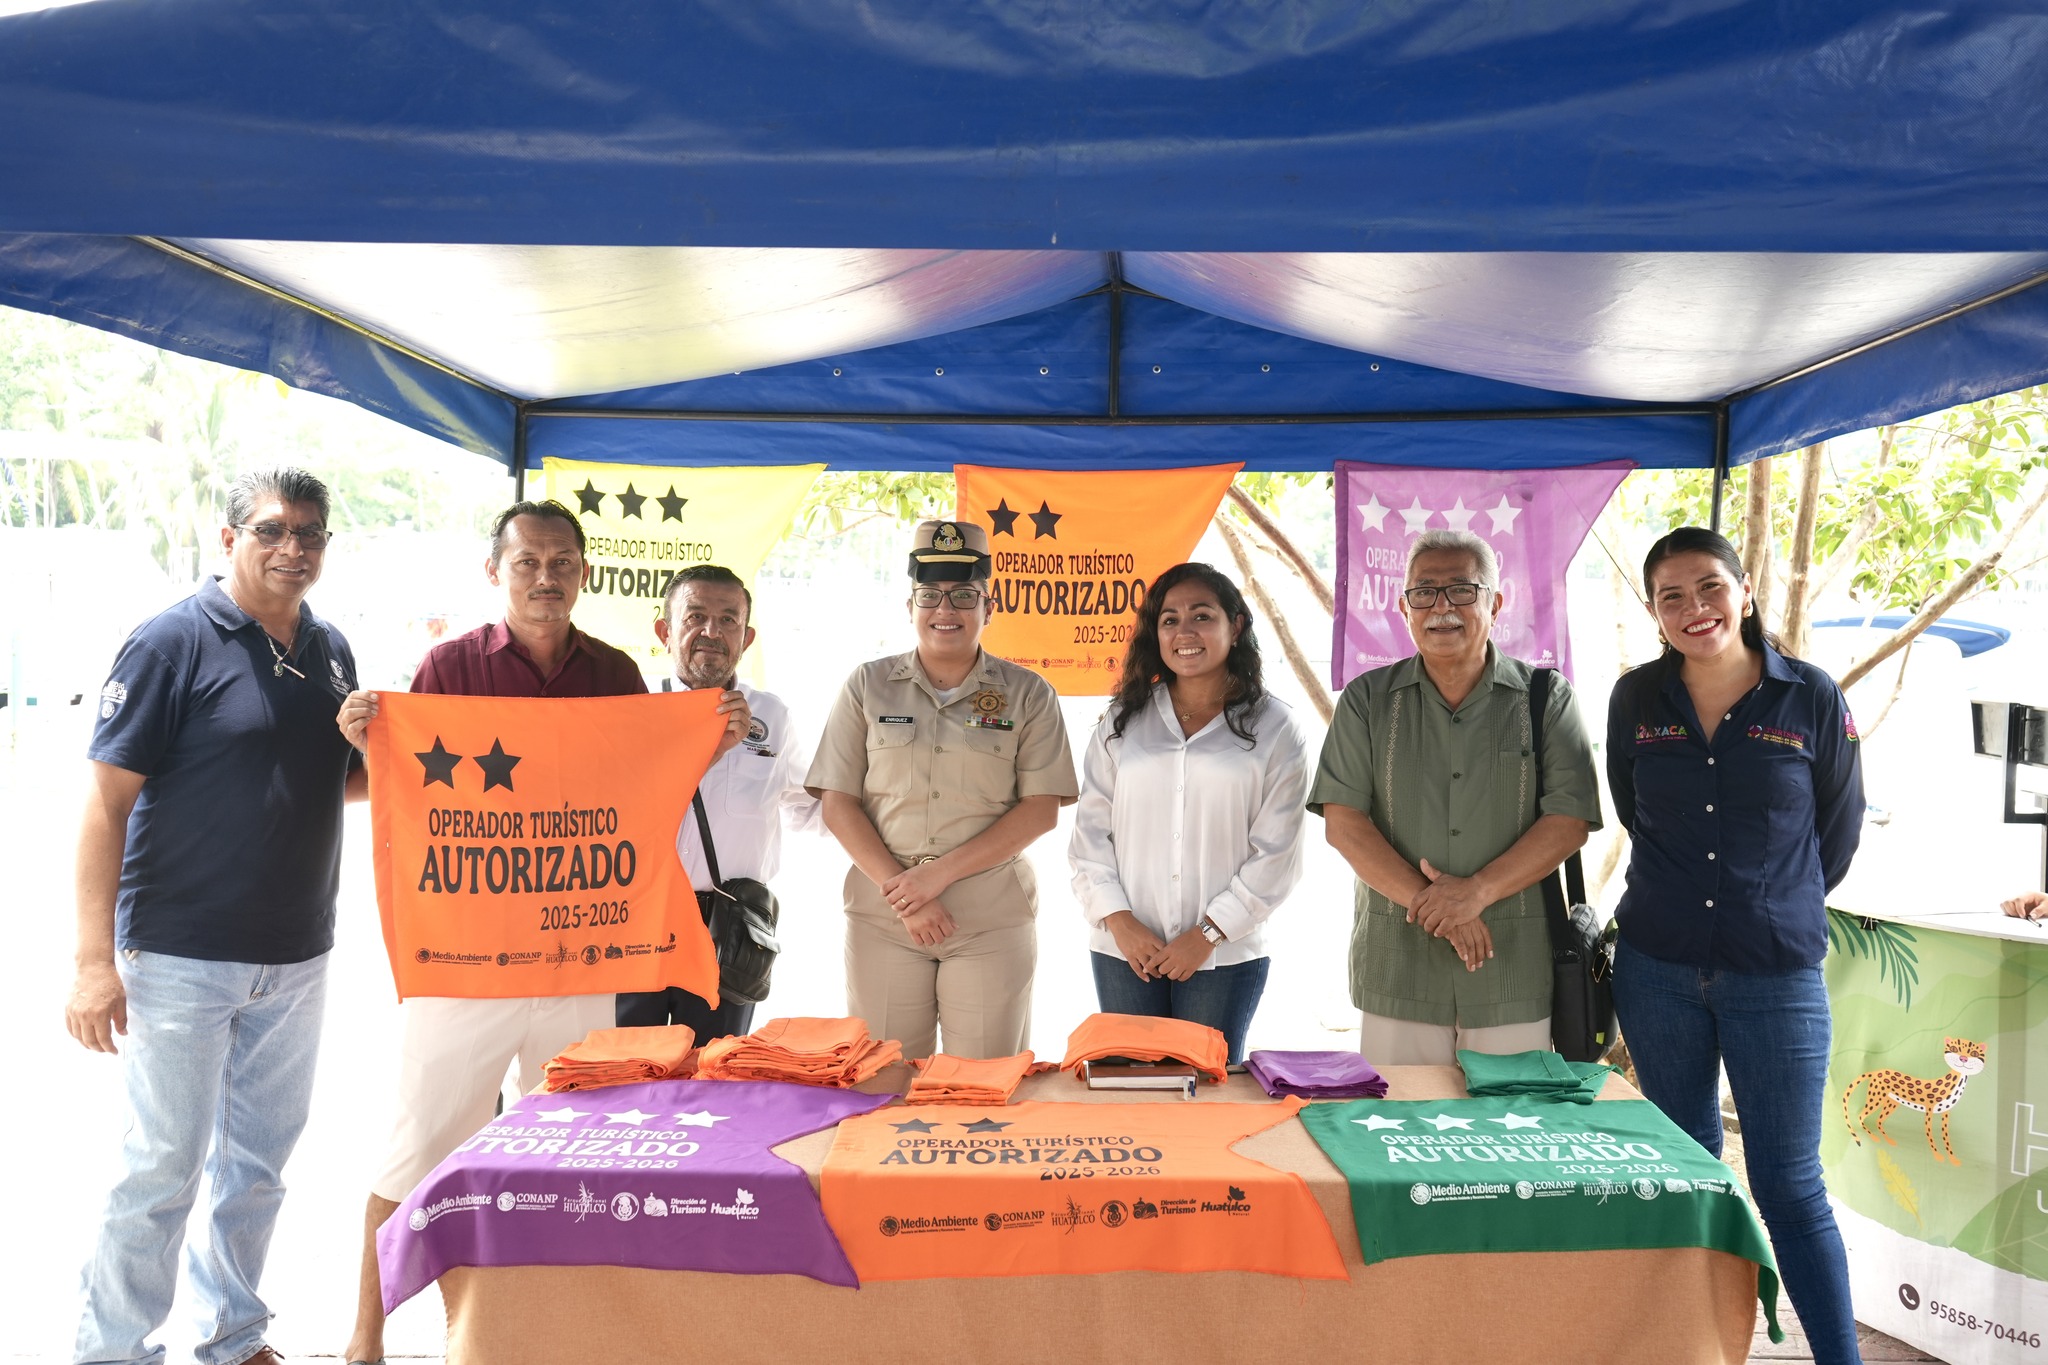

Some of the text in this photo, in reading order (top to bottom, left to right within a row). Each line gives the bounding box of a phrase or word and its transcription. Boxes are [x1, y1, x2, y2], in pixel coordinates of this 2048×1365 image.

[650, 537, 713, 561] TURÍSTICO
[996, 549, 1134, 575] OPERADOR TURÍSTICO
[1366, 547, 1406, 571] OPERA
[583, 565, 675, 598] UTORIZ
[991, 578, 1147, 615] AUTORIZADO
[428, 801, 618, 839] OPERADOR TURÍSTICO
[418, 840, 636, 895] AUTORIZADO
[540, 900, 629, 931] 2025-2026
[432, 951, 492, 962] Medio Ambiente
[510, 952, 542, 960] CONANP
[480, 1126, 688, 1140] ERADOR TURÍSTICO
[1381, 1131, 1617, 1146] OPERADOR TURÍSTICO
[456, 1136, 700, 1157] UTORIZADO
[897, 1134, 1134, 1149] OPERADOR TURÍSTICO
[879, 1147, 1163, 1165] AUTORIZADO
[1388, 1143, 1662, 1163] AUTORIZADO
[557, 1158, 679, 1169] 2025-2026
[1556, 1163, 1679, 1175] 2025-2026
[1040, 1166, 1161, 1181] 2025-2026
[1432, 1183, 1510, 1197] Medio Ambiente
[1534, 1180, 1577, 1190] CONANP
[1584, 1184, 1629, 1196] HUATULCO
[1693, 1182, 1726, 1194] Turismo
[517, 1193, 558, 1203] CONANP
[670, 1198, 698, 1206] Dirección
[1160, 1199, 1188, 1207] Dirección
[427, 1197, 455, 1217] Medio
[455, 1193, 492, 1206] Ambiente
[564, 1202, 606, 1213] HUATULCO
[670, 1205, 707, 1214] Turismo
[710, 1203, 760, 1216] Huatulco
[1161, 1205, 1196, 1215] Turismo
[1201, 1201, 1251, 1212] Huatulco
[900, 1216, 978, 1229] Medio Ambiente
[1002, 1210, 1045, 1222] CONANP
[1052, 1214, 1095, 1226] HUATULCO
[1930, 1300, 2041, 1349] 95858-70446
